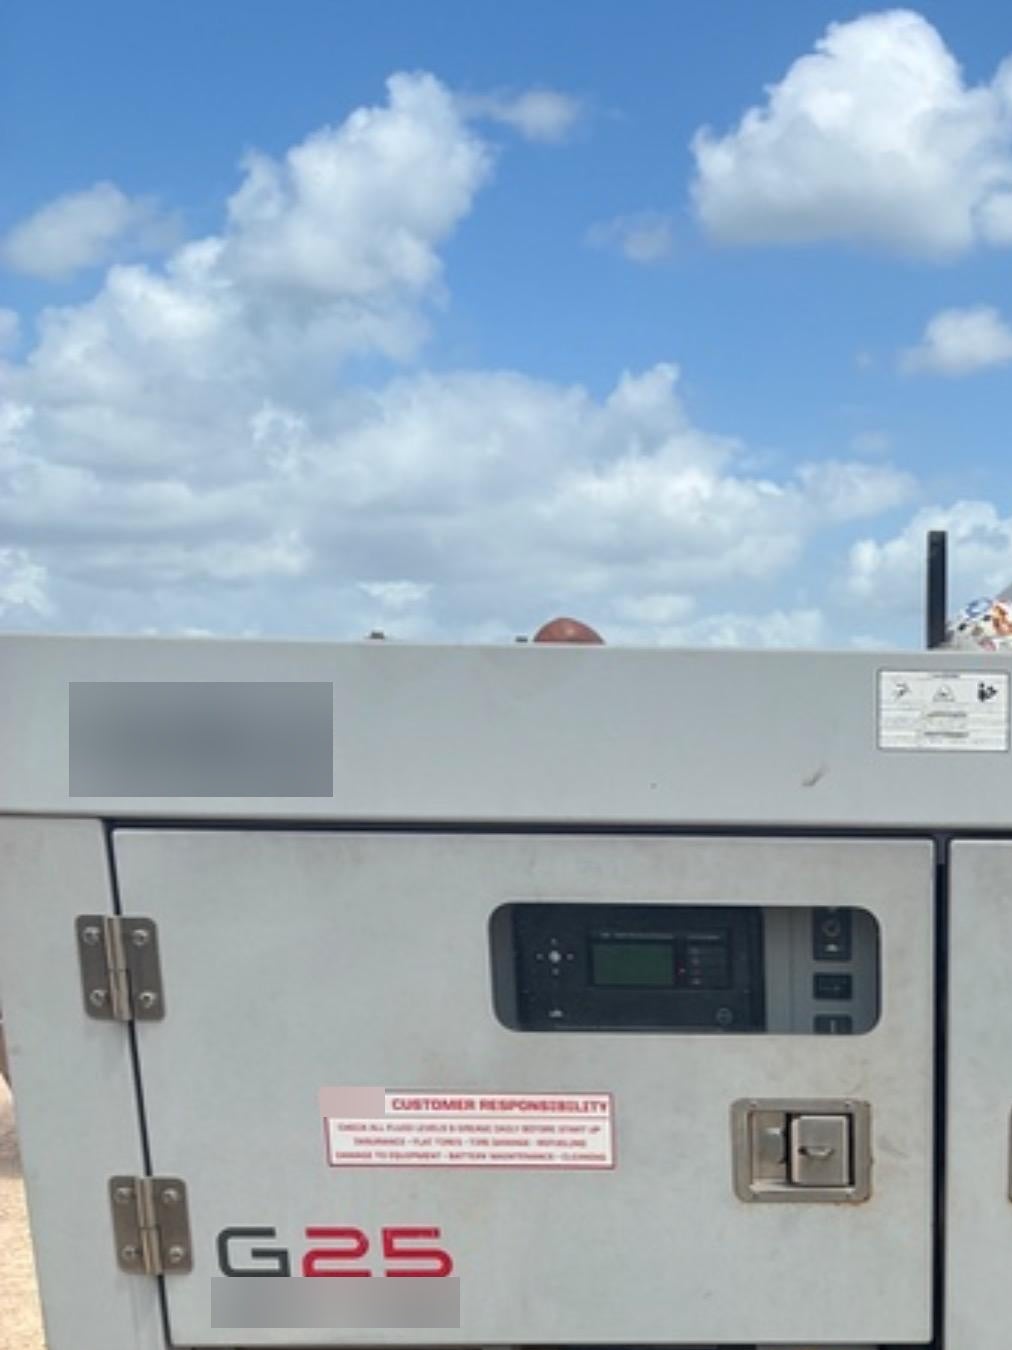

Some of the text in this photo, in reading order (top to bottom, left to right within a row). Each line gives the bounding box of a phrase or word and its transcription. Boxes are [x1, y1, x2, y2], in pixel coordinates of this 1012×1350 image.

[391, 1098, 607, 1112] CUSTOMER RESPONSIBILITY
[216, 1227, 454, 1278] G25
